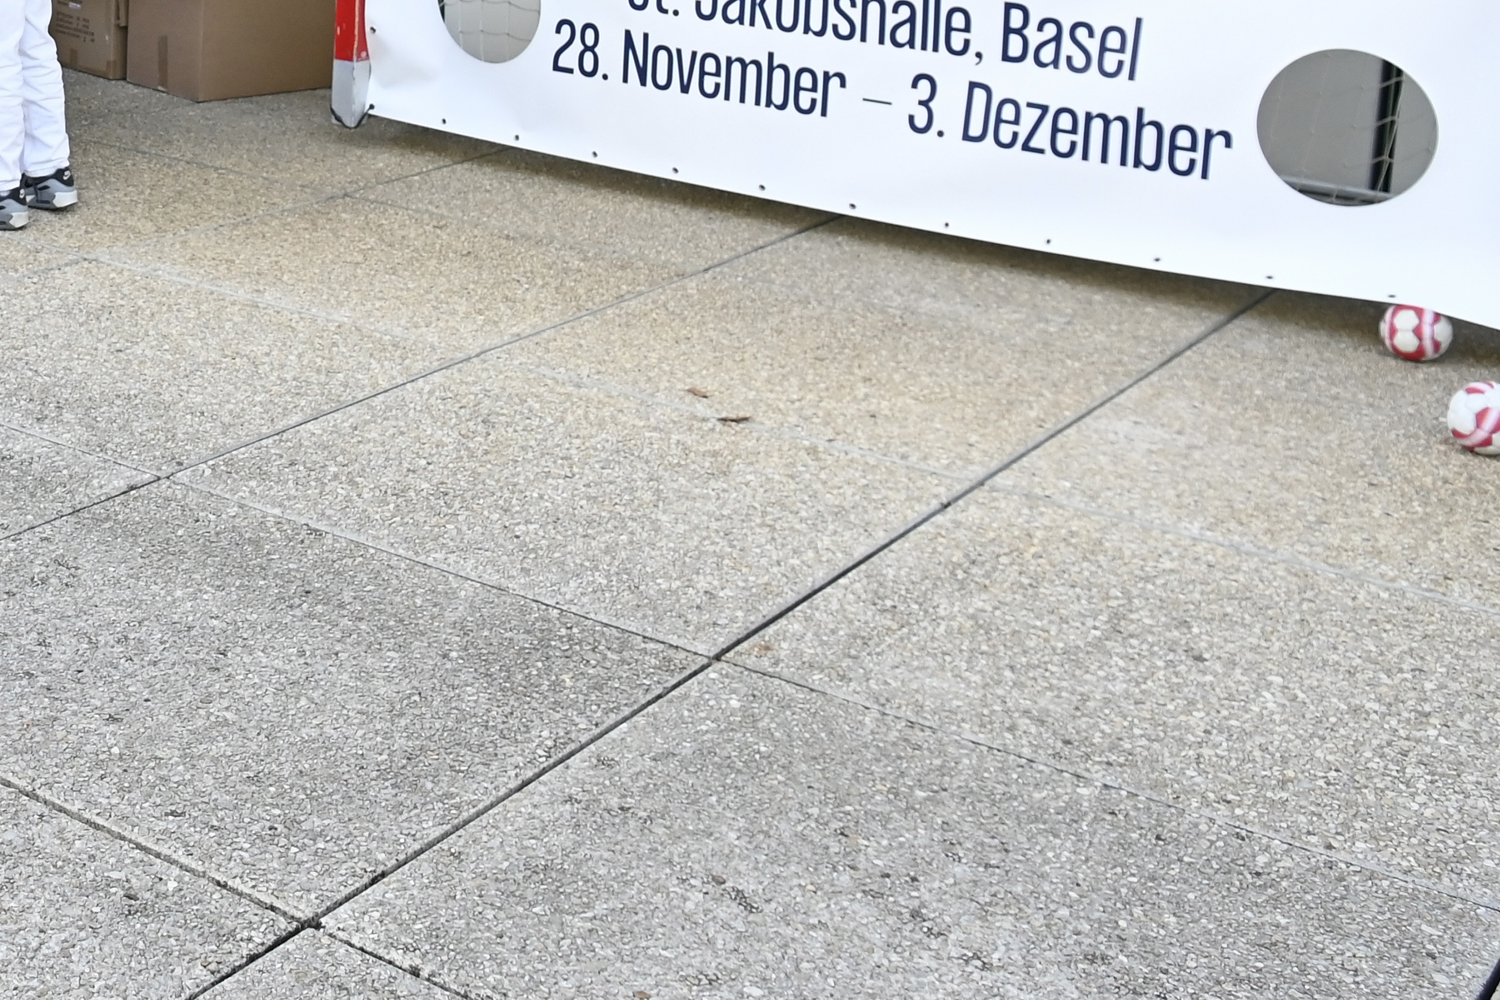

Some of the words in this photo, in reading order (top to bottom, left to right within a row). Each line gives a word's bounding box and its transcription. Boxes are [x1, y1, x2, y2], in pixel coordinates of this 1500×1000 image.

[552, 19, 609, 81] 28.
[622, 28, 846, 117] November
[908, 73, 945, 138] 3.
[961, 80, 1233, 180] Dezember
[1001, 1, 1143, 80] Basel
